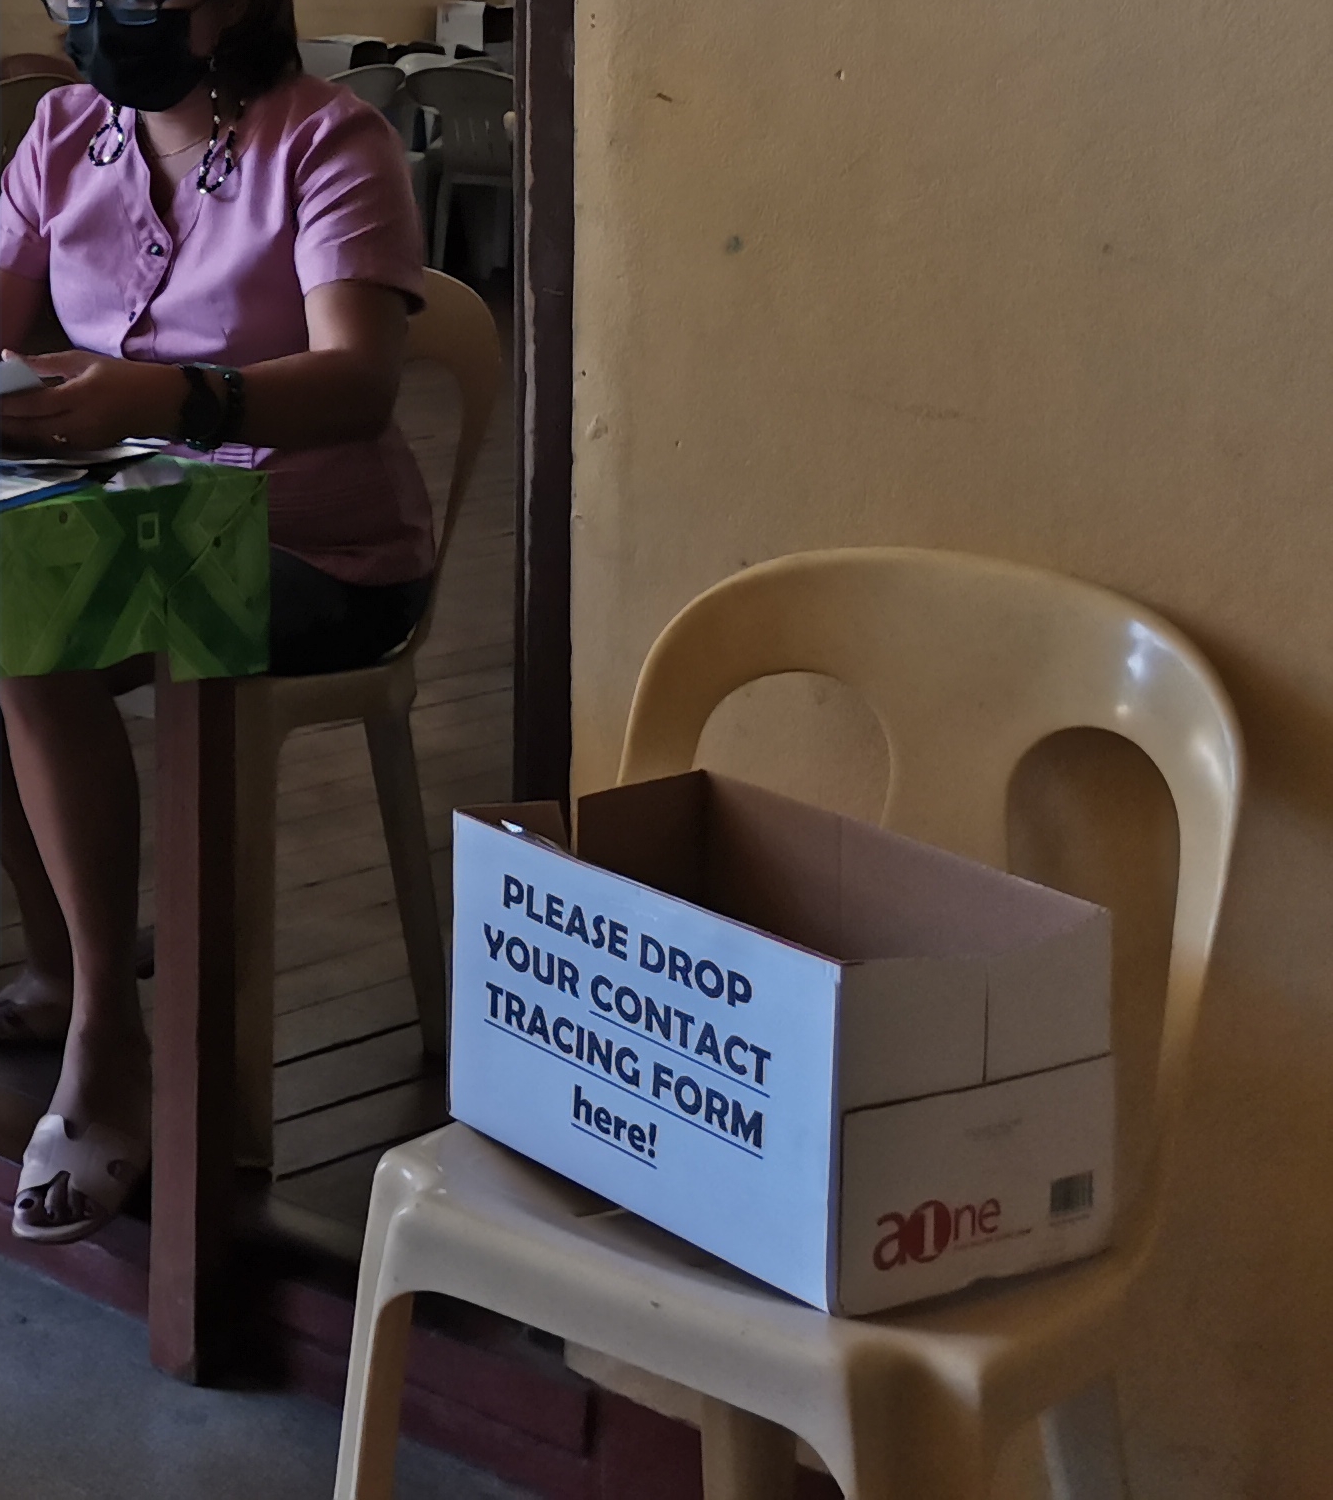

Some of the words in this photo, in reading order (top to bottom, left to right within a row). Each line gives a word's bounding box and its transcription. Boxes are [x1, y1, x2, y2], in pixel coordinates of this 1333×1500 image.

[484, 923, 579, 998] YOUR
[589, 974, 772, 1085] CONTACT
[502, 874, 629, 961] PLEASE
[640, 933, 752, 1009] DROP
[485, 981, 640, 1087] TRACING
[652, 1064, 763, 1151] FORM
[571, 1085, 658, 1159] here!
